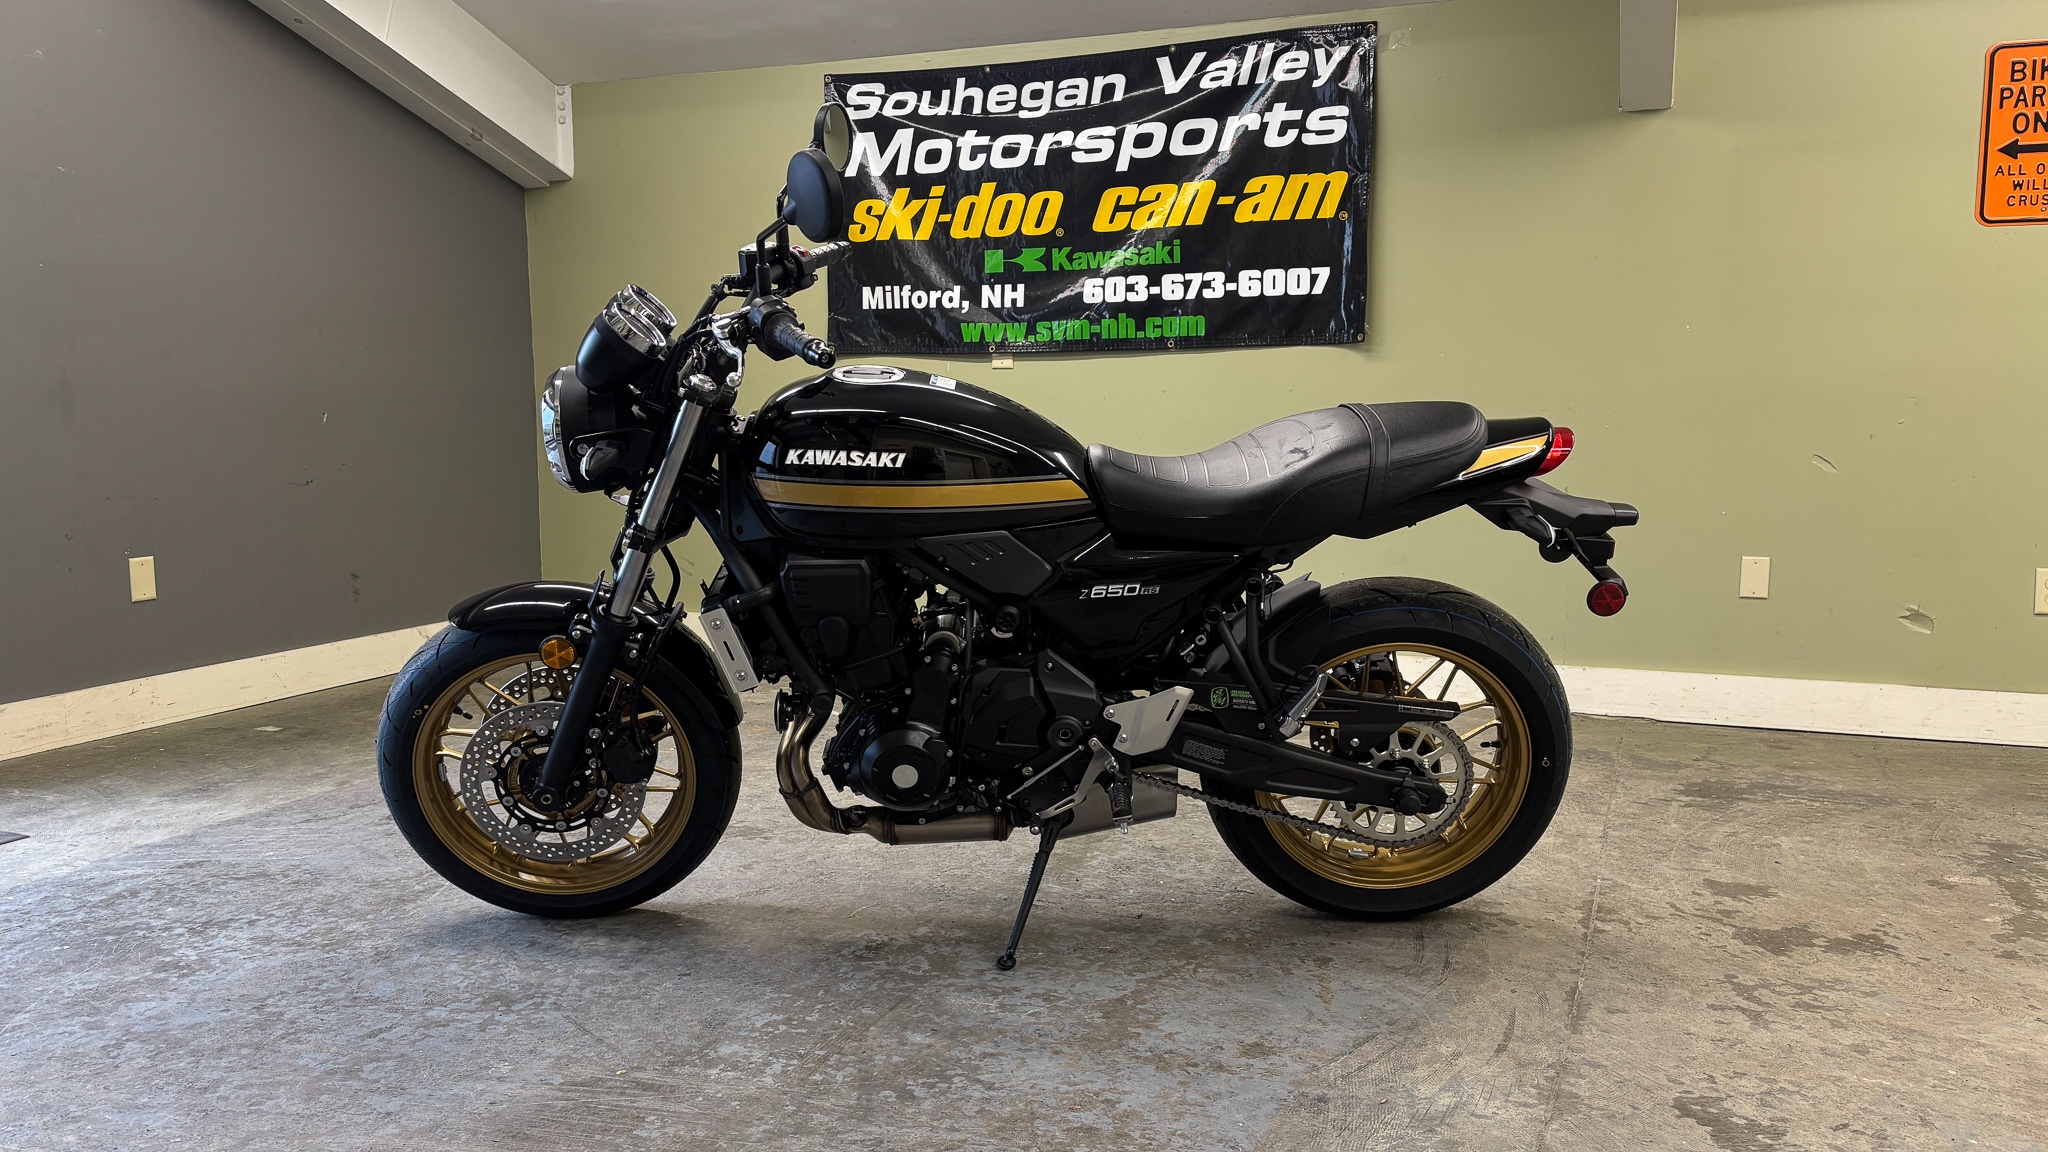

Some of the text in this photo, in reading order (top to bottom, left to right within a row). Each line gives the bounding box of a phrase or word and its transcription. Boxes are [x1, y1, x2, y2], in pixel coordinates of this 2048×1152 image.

[845, 42, 1350, 121] Souhegan Valley
[1999, 85, 2047, 109] PAR
[2012, 110, 2048, 134] ON
[845, 102, 1349, 176] Motorsports
[1994, 163, 2027, 177] ALL
[2012, 178, 2048, 191] WILL
[848, 170, 1348, 242] ski-doo can-am
[2006, 193, 2048, 207] CRUS
[1052, 240, 1181, 271] Kawasaki
[862, 266, 1331, 312] Milford, NH 603-673-6007
[960, 312, 1206, 344] www.svm-nh.com
[784, 448, 907, 468] KAWASAKI
